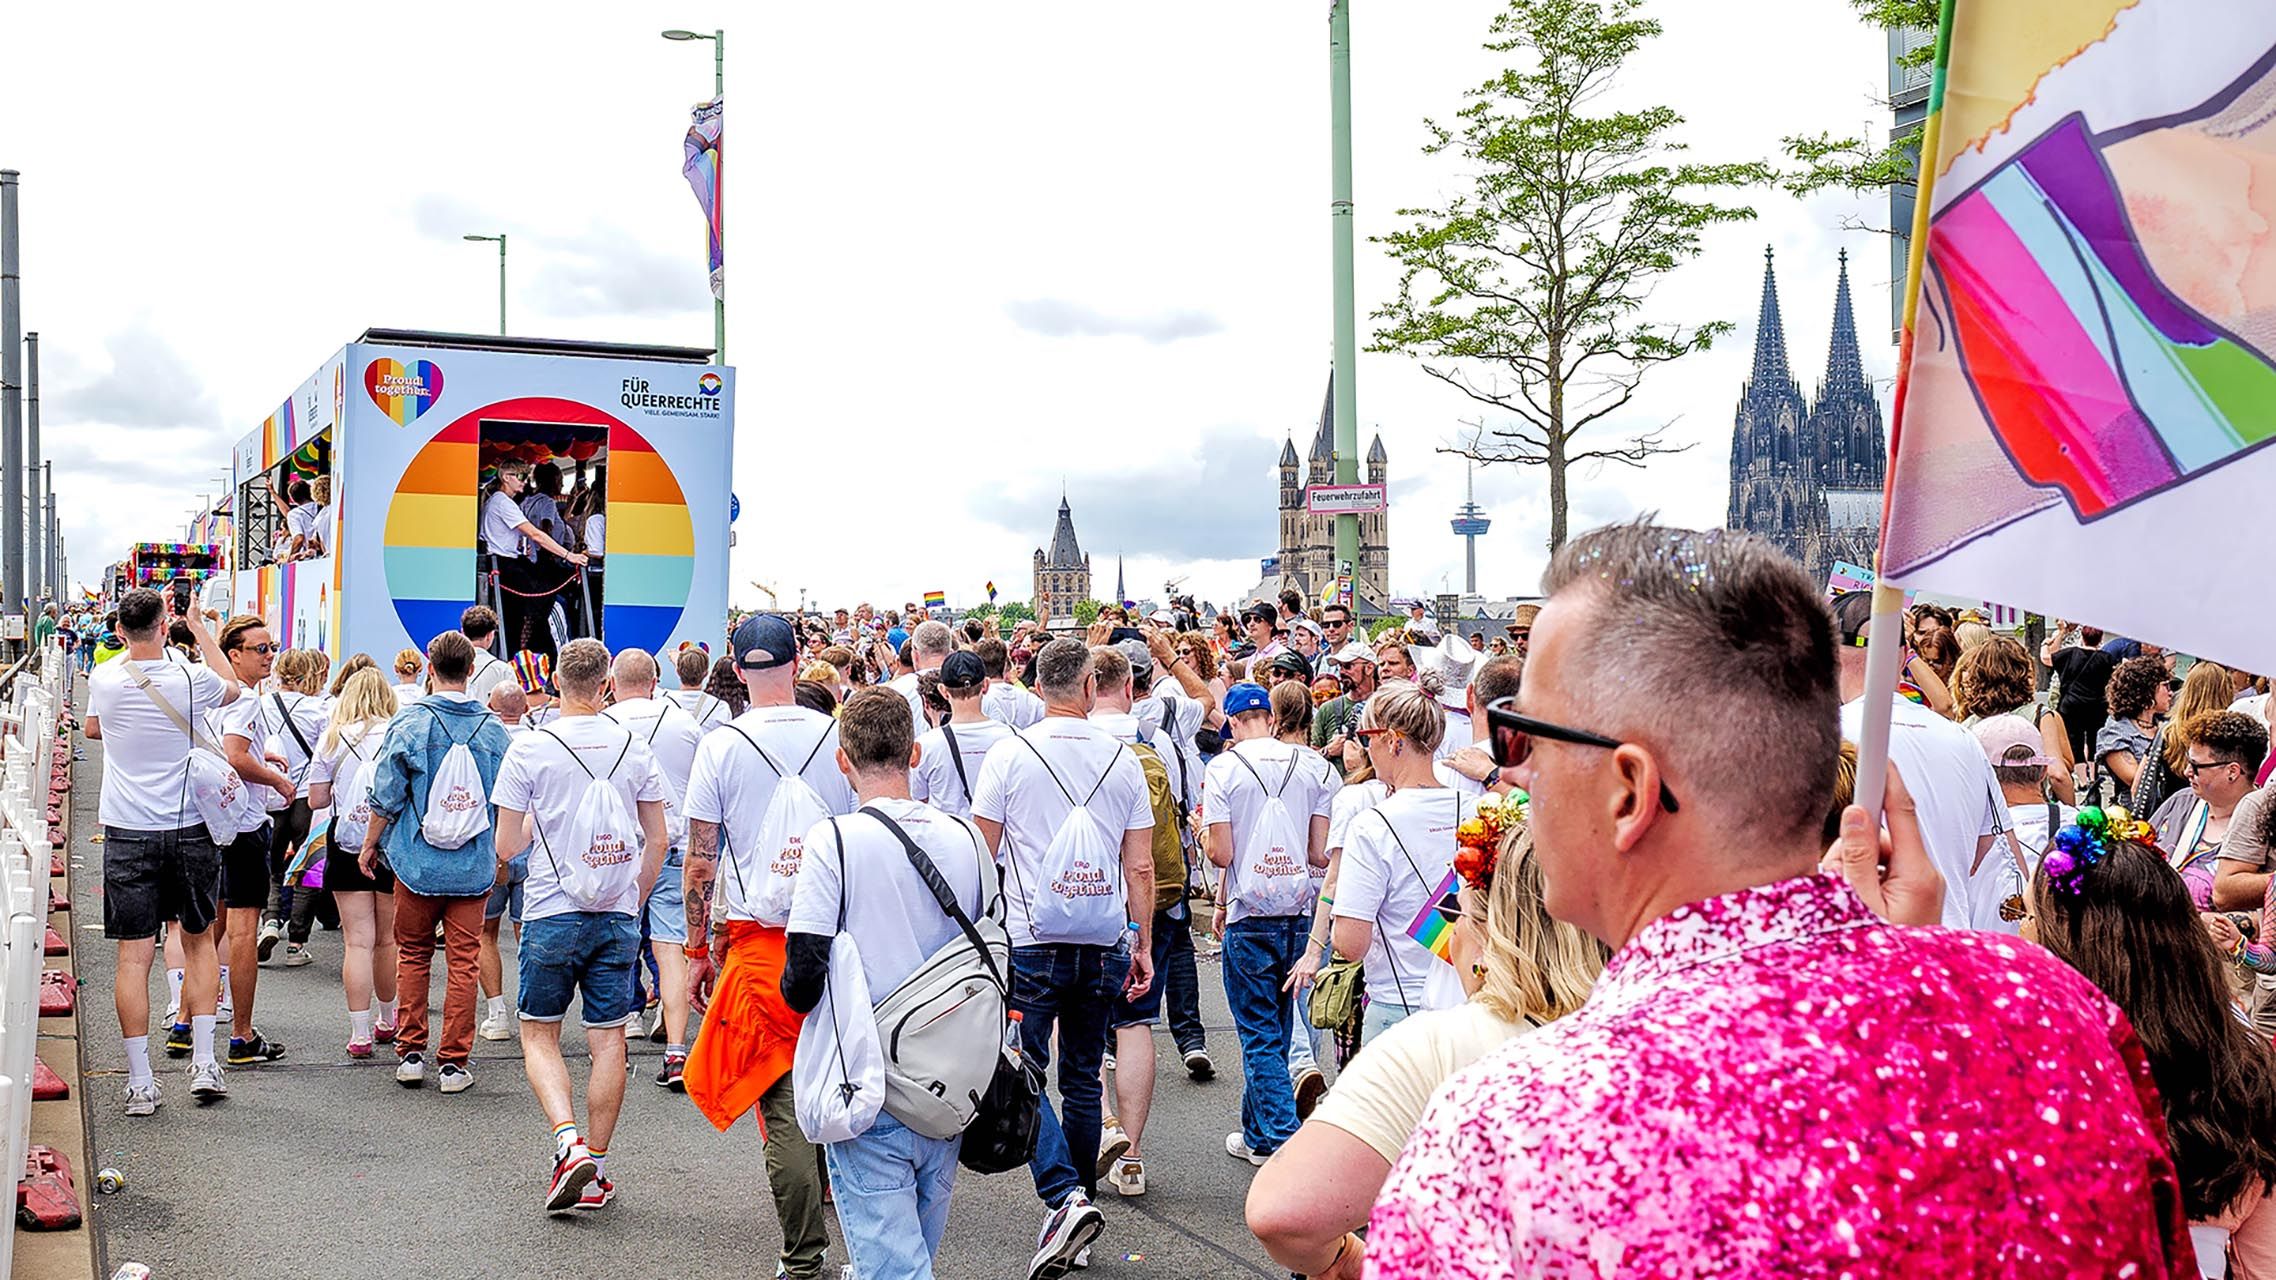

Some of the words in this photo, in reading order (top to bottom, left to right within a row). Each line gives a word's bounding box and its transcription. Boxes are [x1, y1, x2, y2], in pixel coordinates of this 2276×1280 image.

[374, 384, 431, 397] together.
[622, 377, 649, 393] FÜR
[621, 393, 720, 411] QUEERRECHTE
[1312, 490, 1381, 502] Feuerwehrzufahrt
